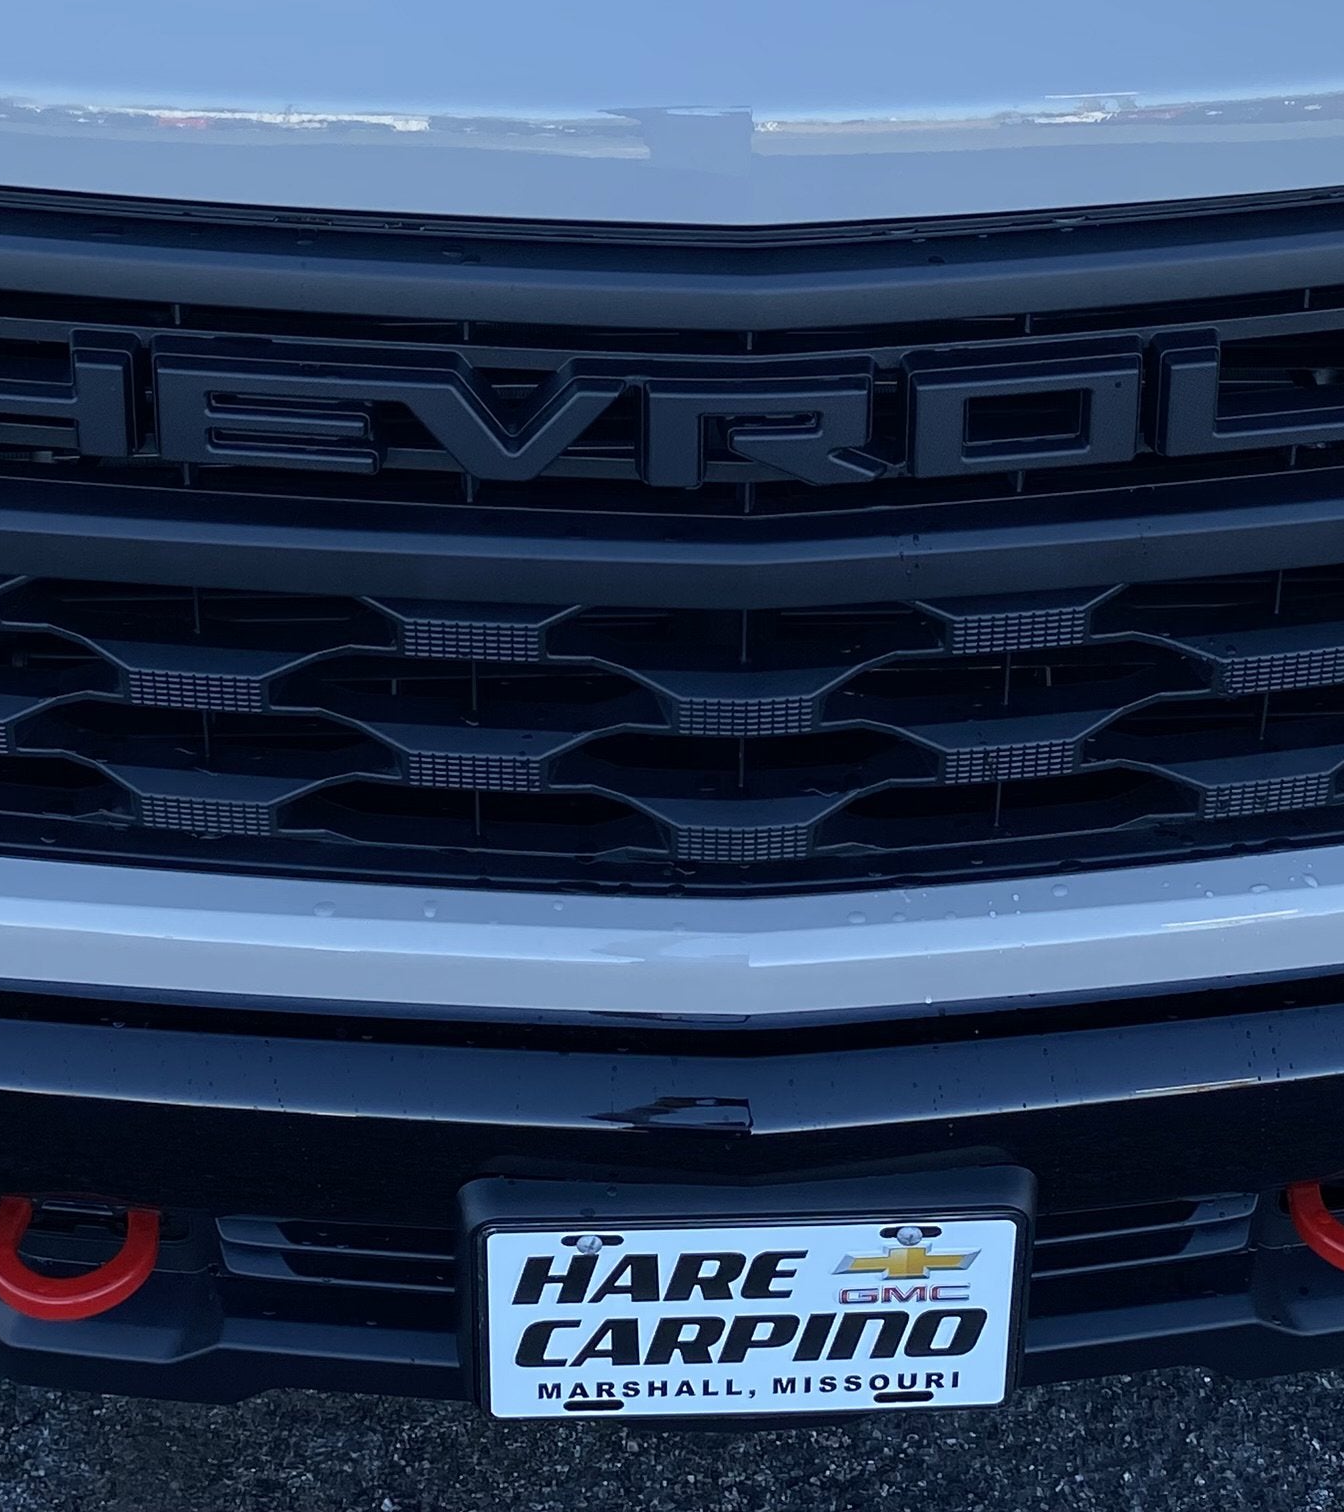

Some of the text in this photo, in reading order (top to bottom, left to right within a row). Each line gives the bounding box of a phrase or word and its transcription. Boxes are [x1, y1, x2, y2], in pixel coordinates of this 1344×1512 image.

[512, 1249, 809, 1306] HARE
[838, 1282, 971, 1305] GMC
[514, 1307, 989, 1368] CARPINO
[537, 1370, 961, 1400] MARSHALL, MISSOURI
